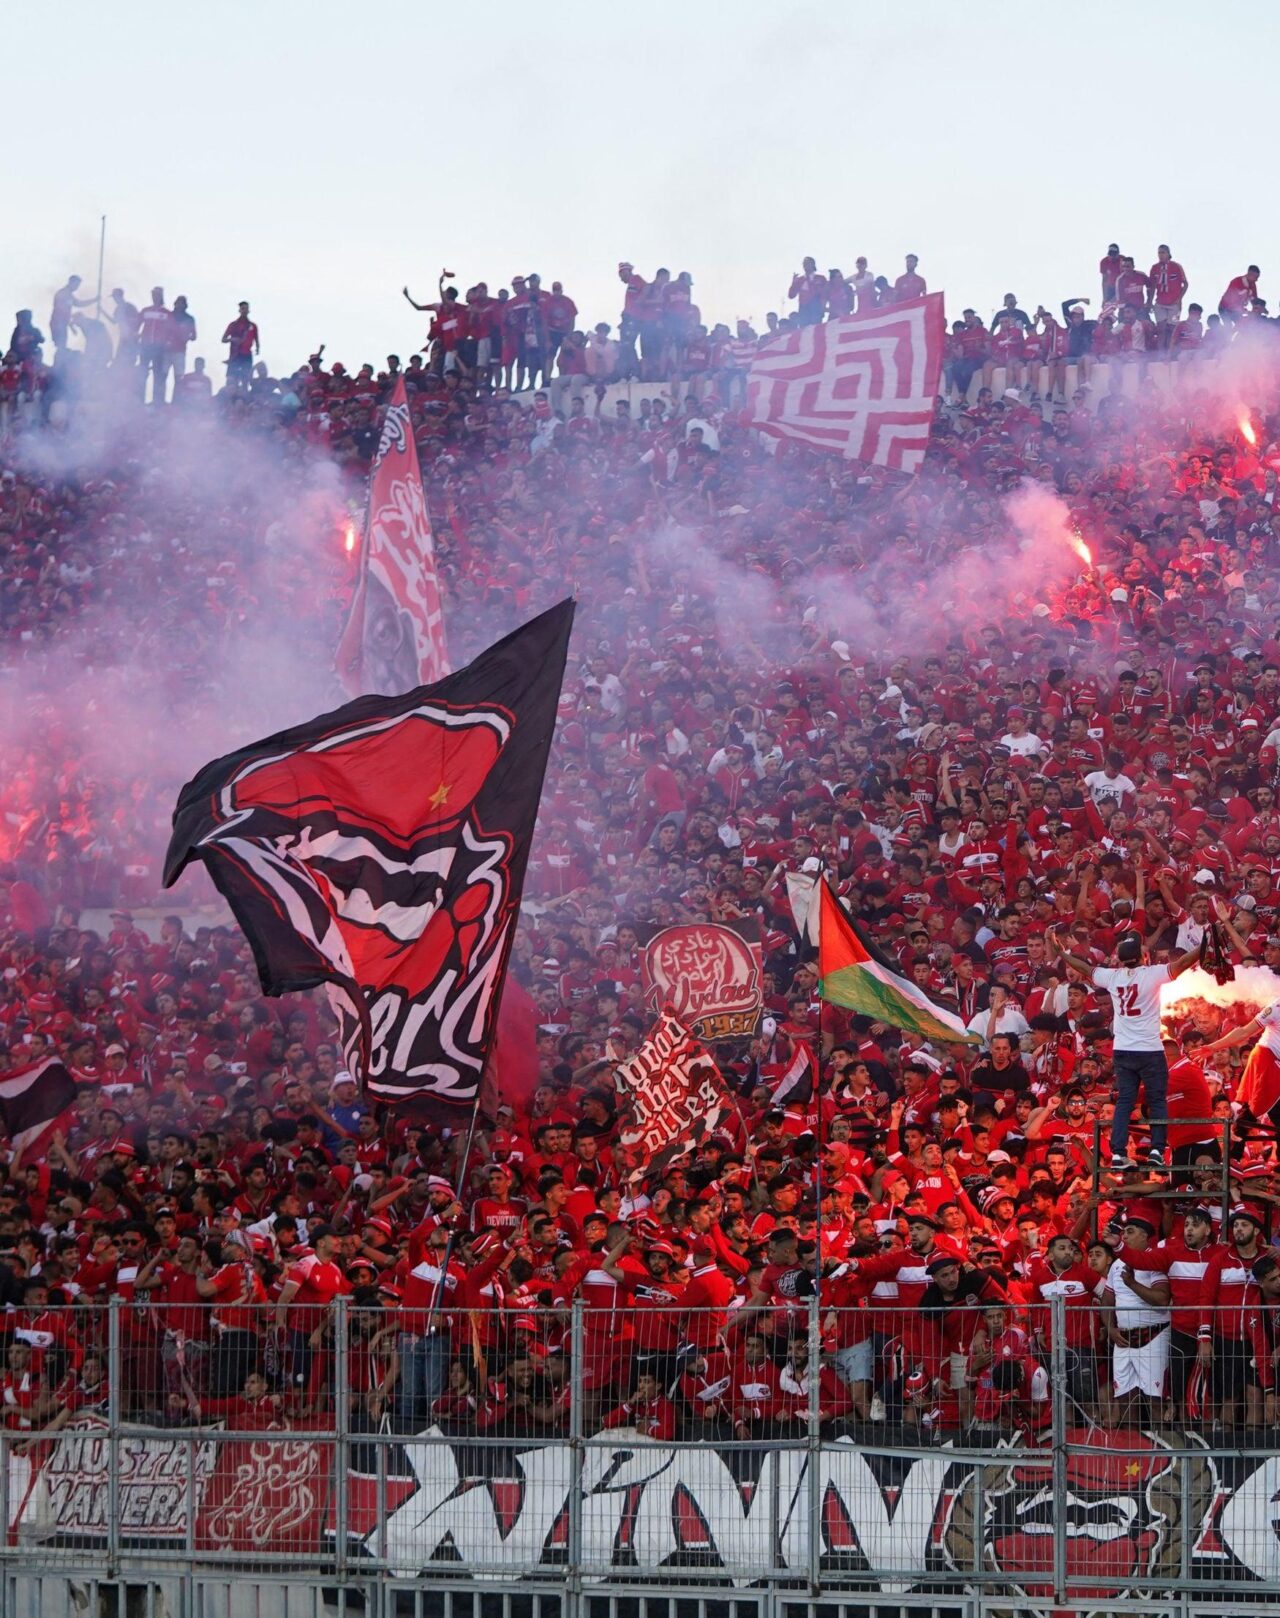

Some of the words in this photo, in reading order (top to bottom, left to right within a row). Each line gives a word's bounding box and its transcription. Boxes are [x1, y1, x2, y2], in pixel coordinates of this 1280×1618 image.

[644, 970, 762, 1020] Wydad
[1116, 984, 1142, 1017] 12
[703, 1011, 757, 1037] 1937
[644, 1078, 719, 1153] alles
[486, 1215, 521, 1226] DEVOTION
